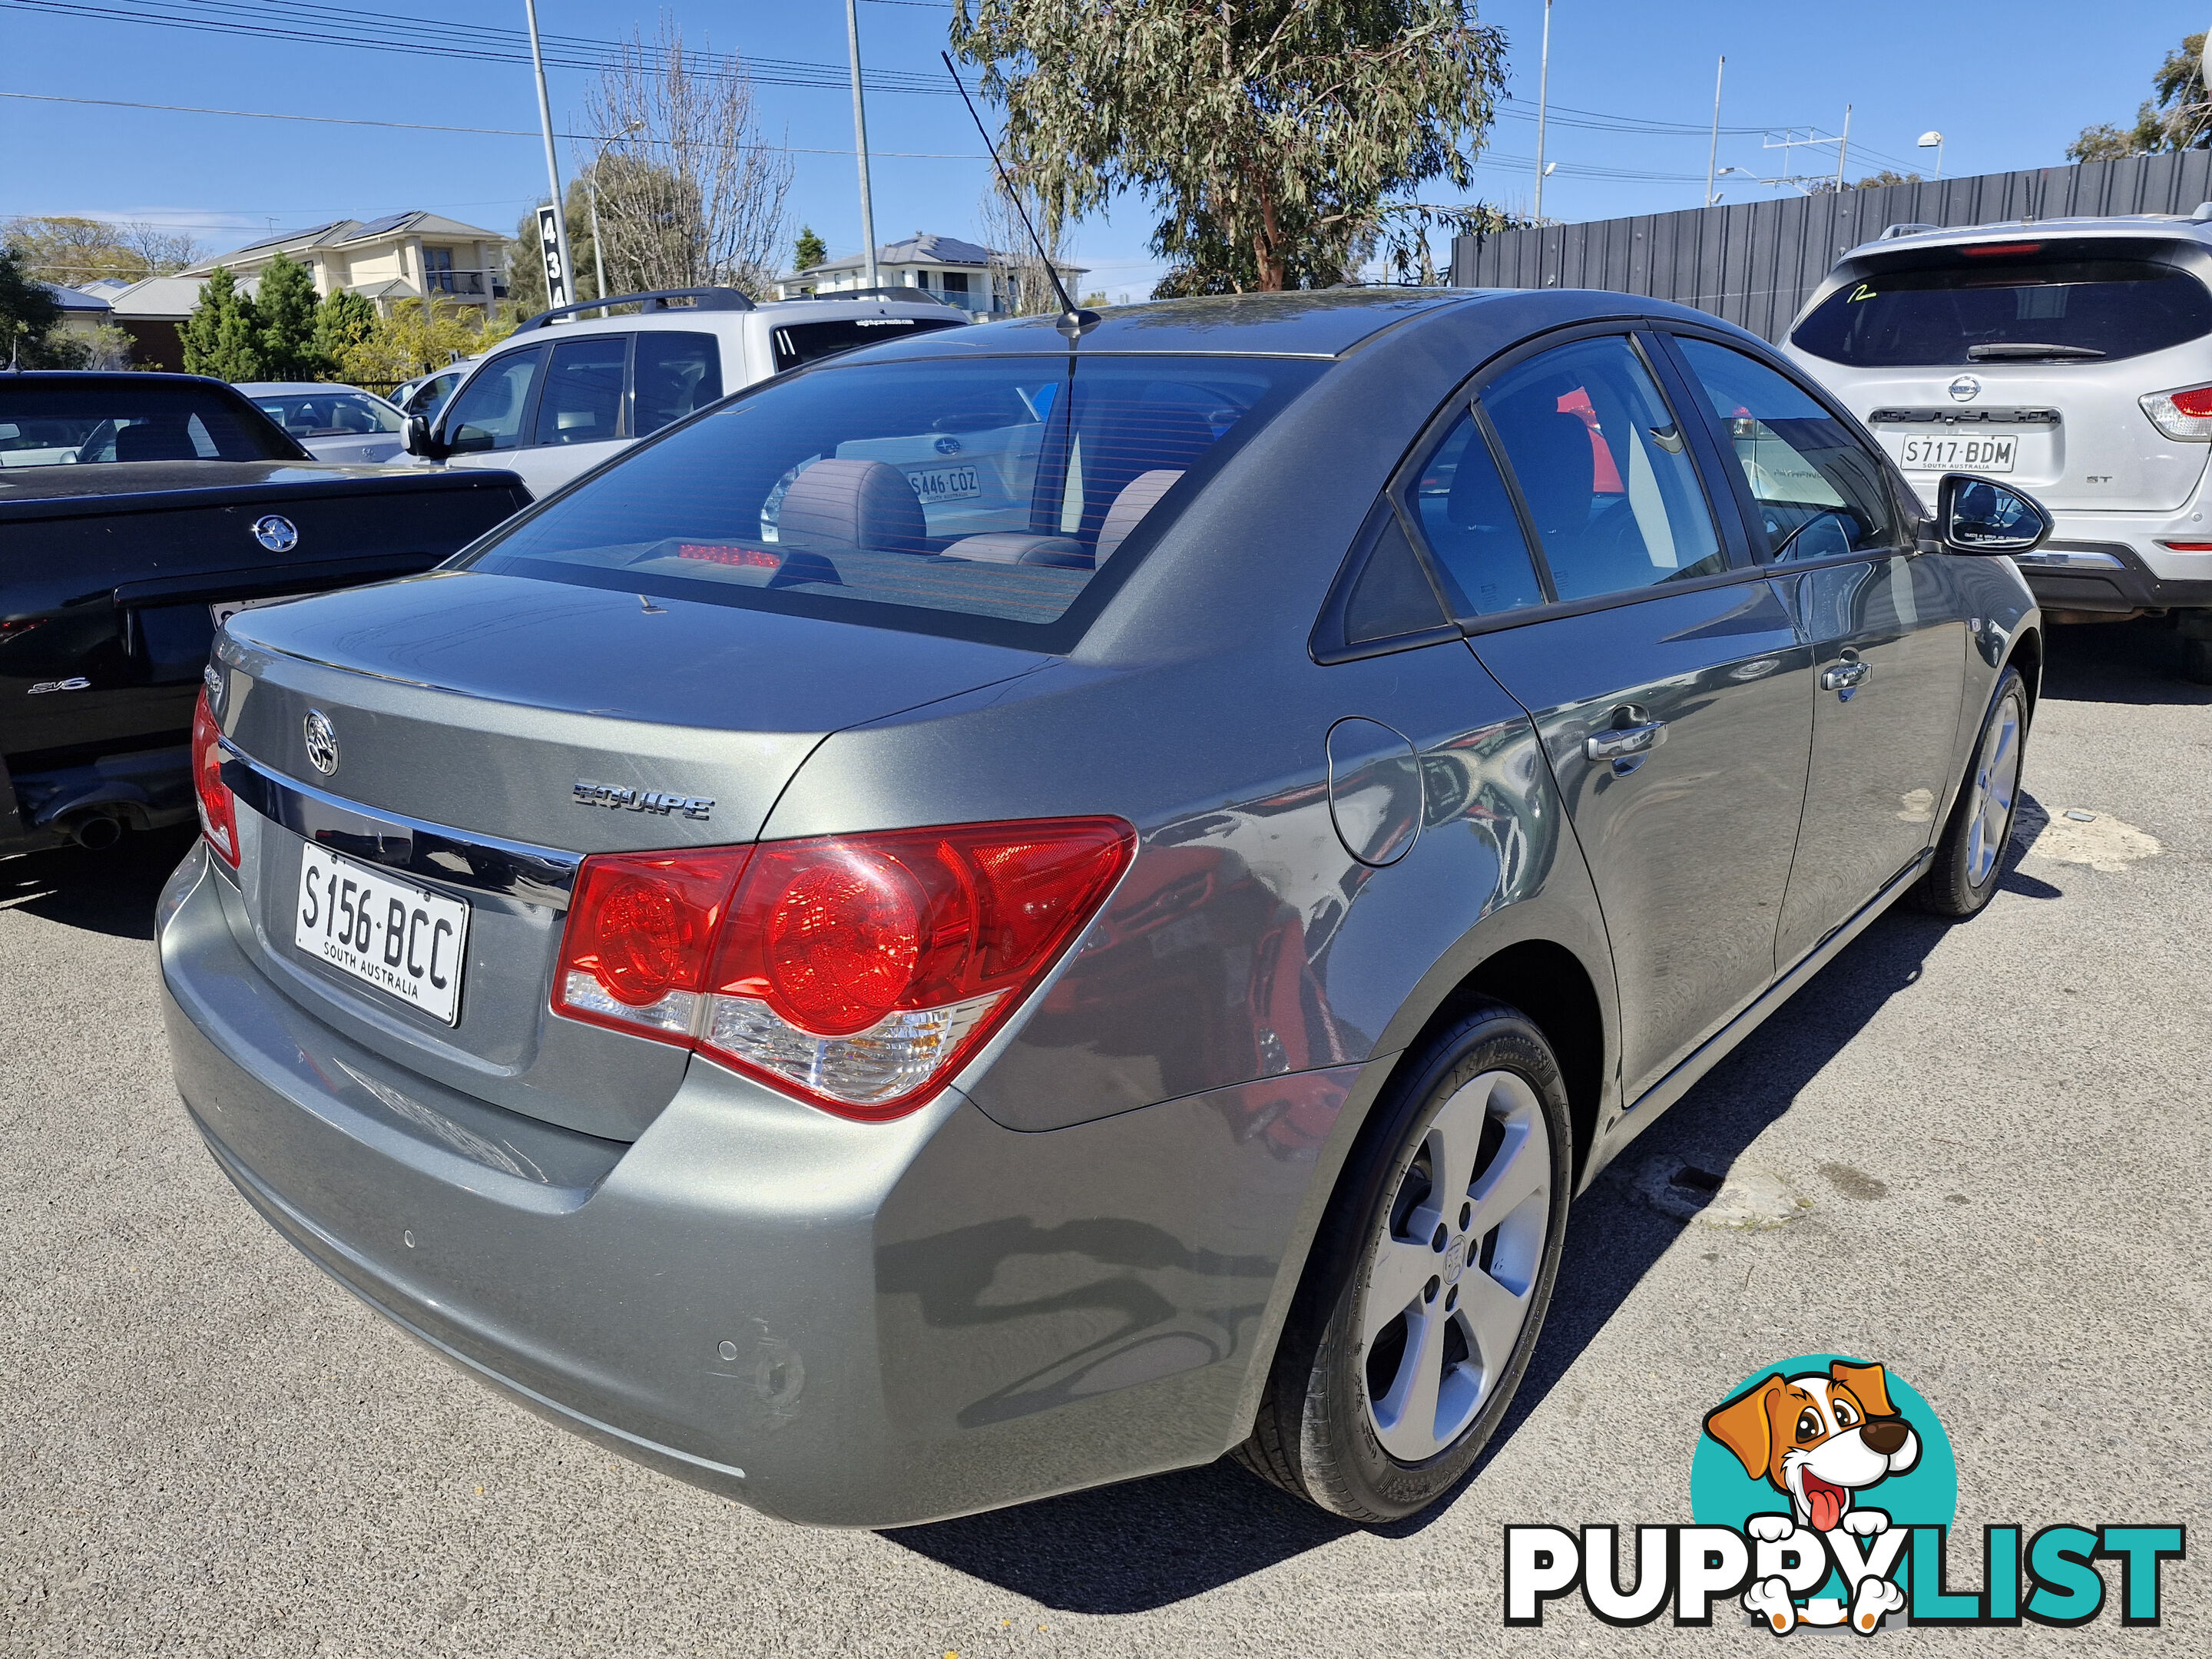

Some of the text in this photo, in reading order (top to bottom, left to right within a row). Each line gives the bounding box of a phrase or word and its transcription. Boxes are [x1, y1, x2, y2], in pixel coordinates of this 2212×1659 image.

[544, 217, 566, 310] 434
[2087, 475, 2113, 484] ST
[28, 677, 91, 694] SV6
[572, 782, 716, 822] EQUIPE
[323, 942, 419, 1000] SOUTH AUSTRALIA
